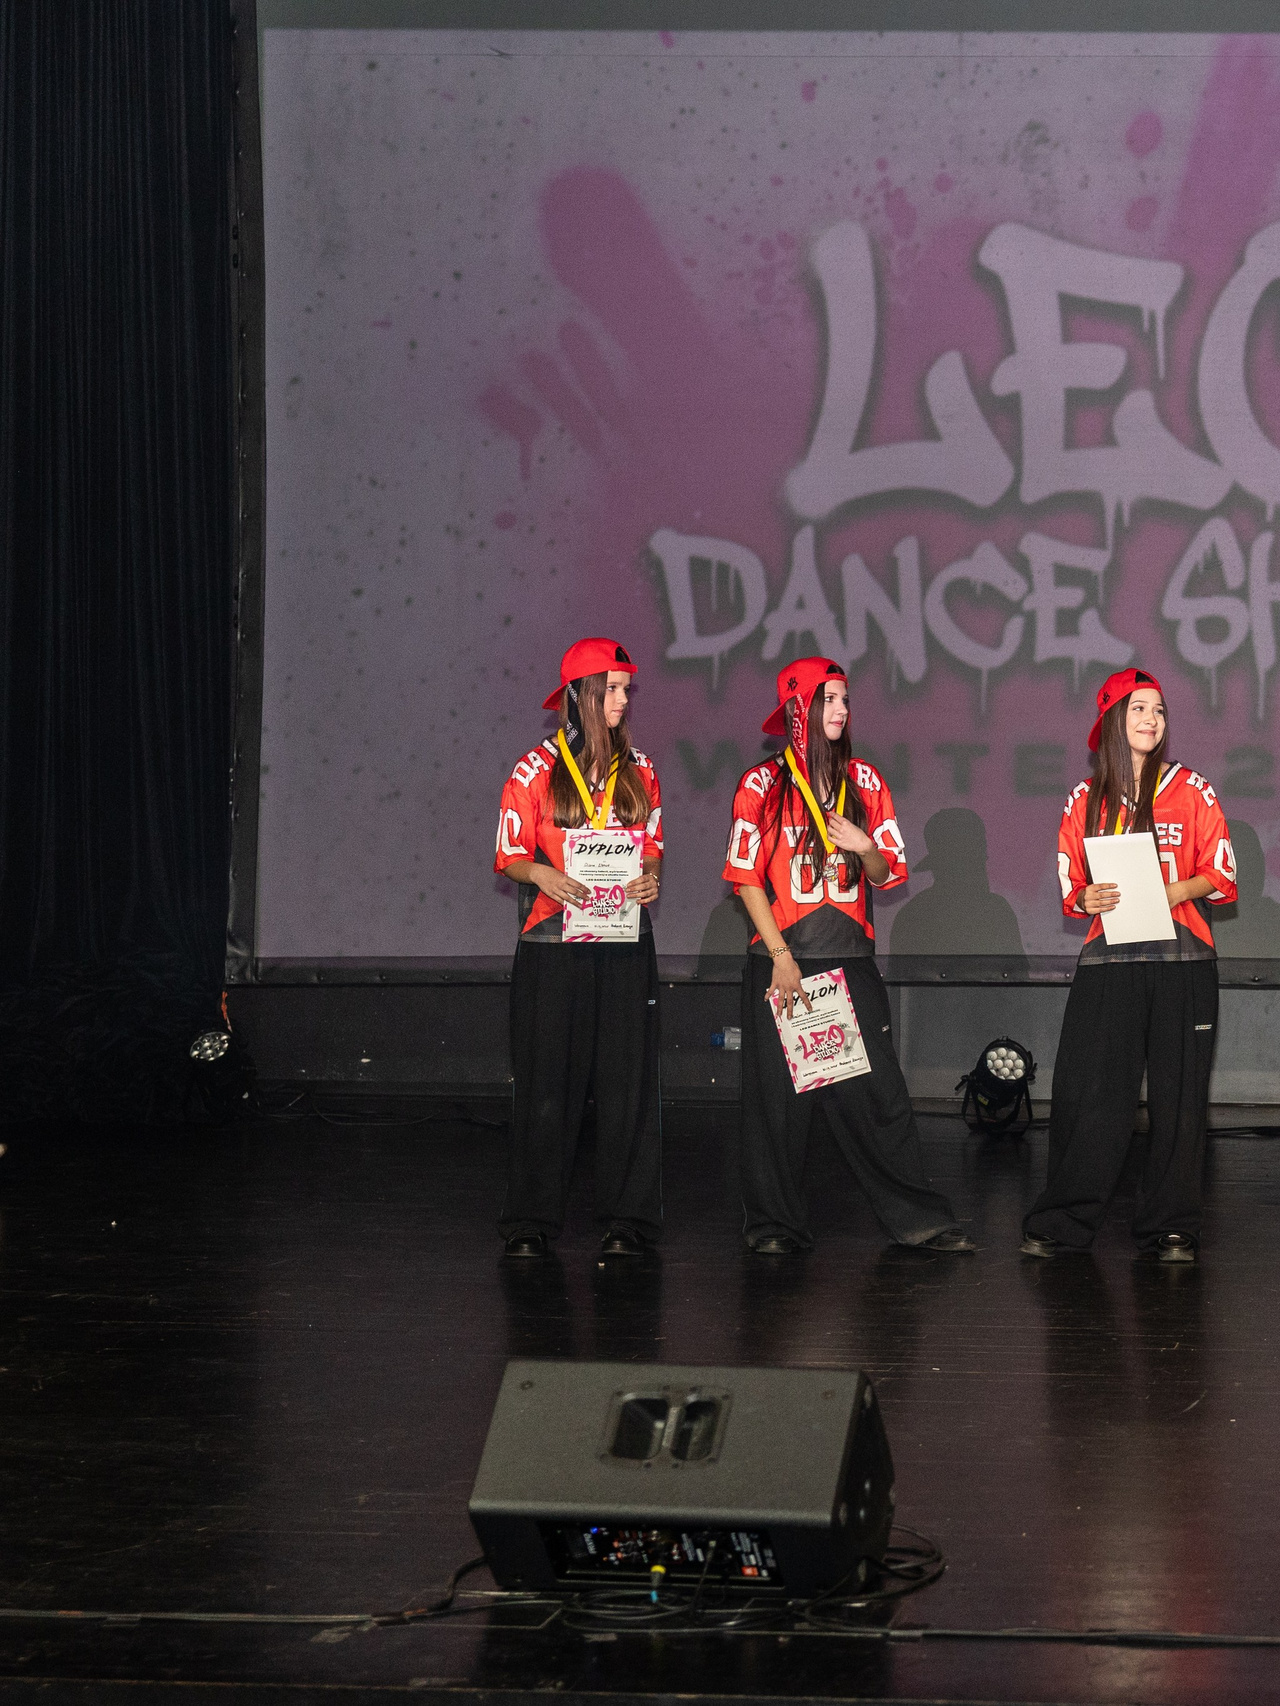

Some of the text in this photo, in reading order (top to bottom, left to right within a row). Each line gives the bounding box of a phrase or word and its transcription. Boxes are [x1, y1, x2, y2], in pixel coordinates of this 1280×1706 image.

[648, 524, 1135, 690] DANCE
[574, 843, 636, 857] DYPLOM
[798, 1024, 845, 1060] LEO
